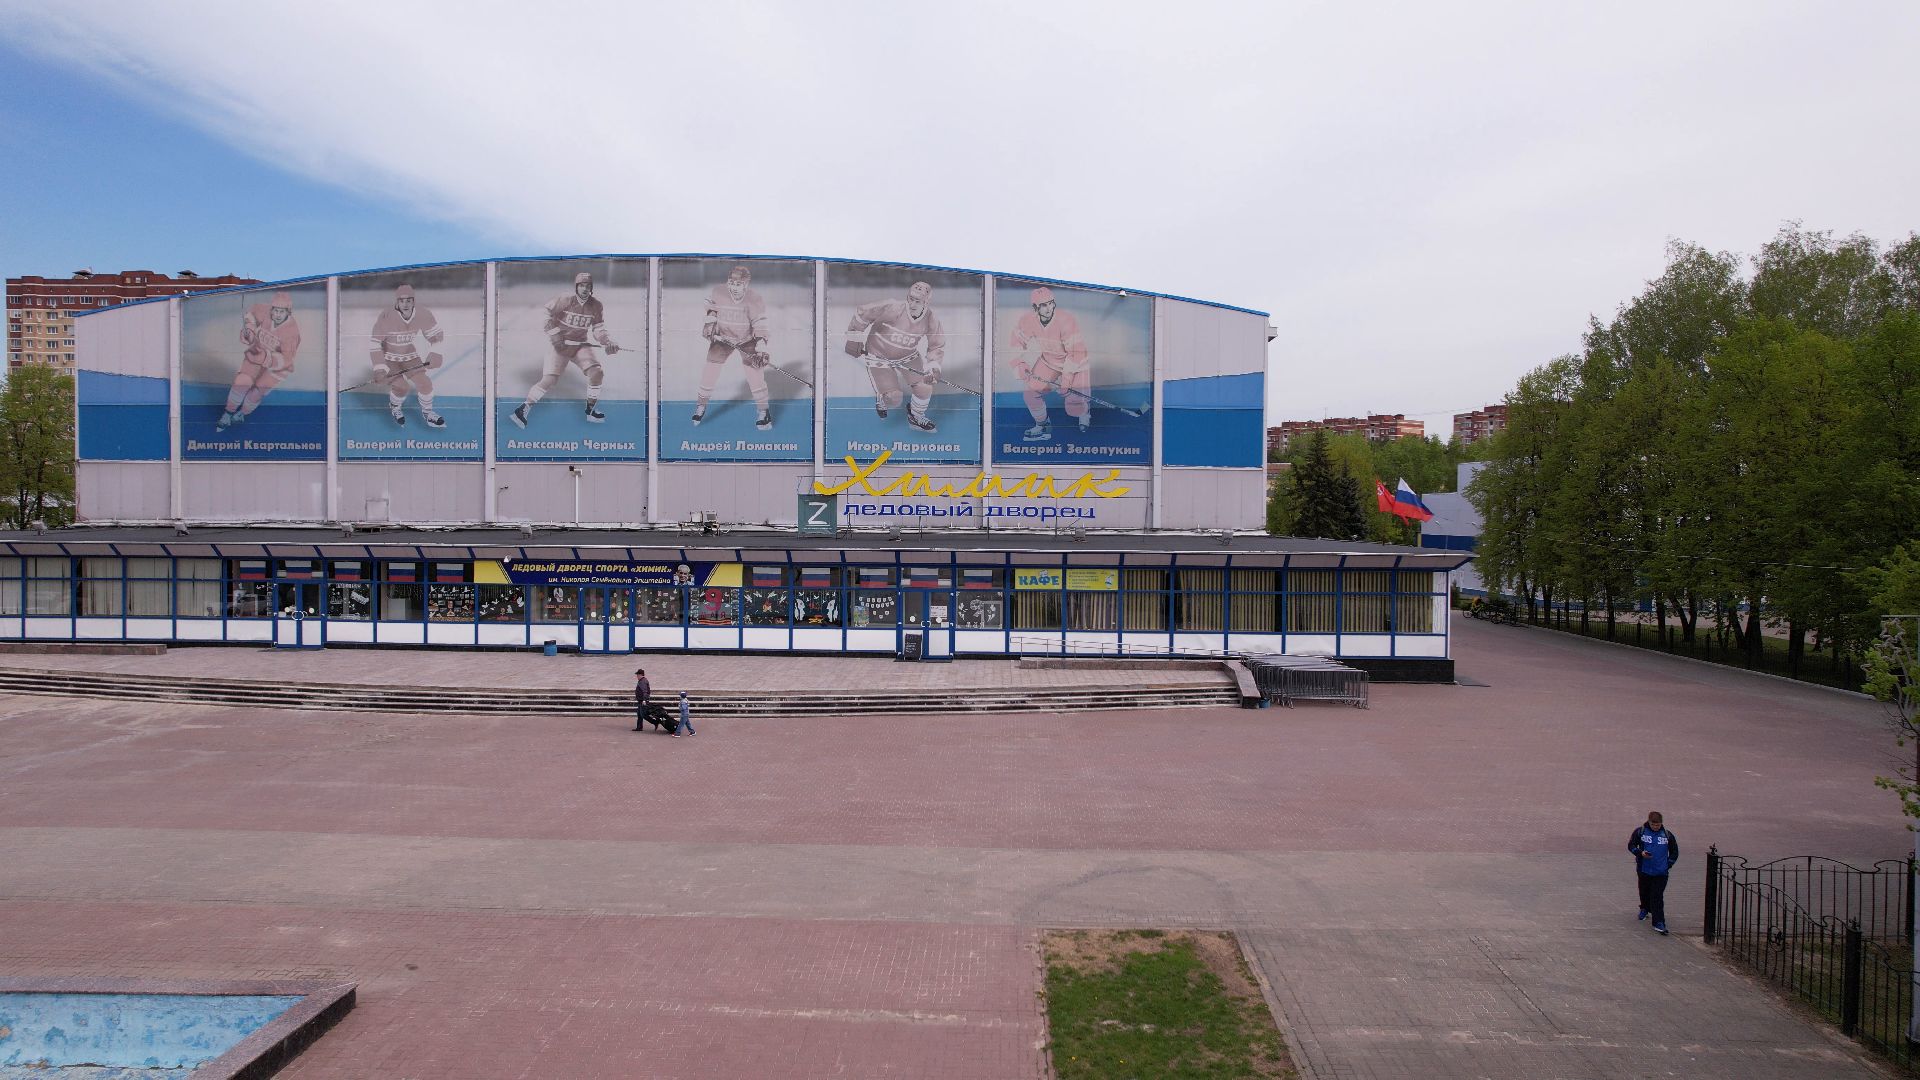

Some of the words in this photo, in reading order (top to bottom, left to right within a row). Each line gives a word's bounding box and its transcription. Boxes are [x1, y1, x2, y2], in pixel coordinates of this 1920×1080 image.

[187, 439, 241, 451] Дмитрий
[244, 439, 322, 451] Квартальнов
[346, 439, 402, 451] Валерий
[406, 439, 479, 450] Каменский
[507, 439, 579, 451] Александр
[583, 439, 636, 450] Черных
[680, 440, 731, 452] Андрей
[735, 441, 798, 451] Ломакин
[847, 440, 888, 452] Игорь
[891, 441, 961, 452] Ларионов
[1003, 443, 1062, 455] Валерий
[1066, 444, 1140, 456] Зелепукин
[813, 450, 1131, 498] Химик
[807, 501, 828, 525] Z
[843, 502, 973, 517] ледовый
[985, 504, 1096, 522] дворец
[511, 562, 556, 572] ЛЕДОВЫЙ
[556, 564, 593, 574] ДВОРЕЦ
[595, 565, 629, 573] СПОРТА
[630, 565, 672, 573] «ХИМИК»
[1018, 575, 1060, 586] КАФЕ
